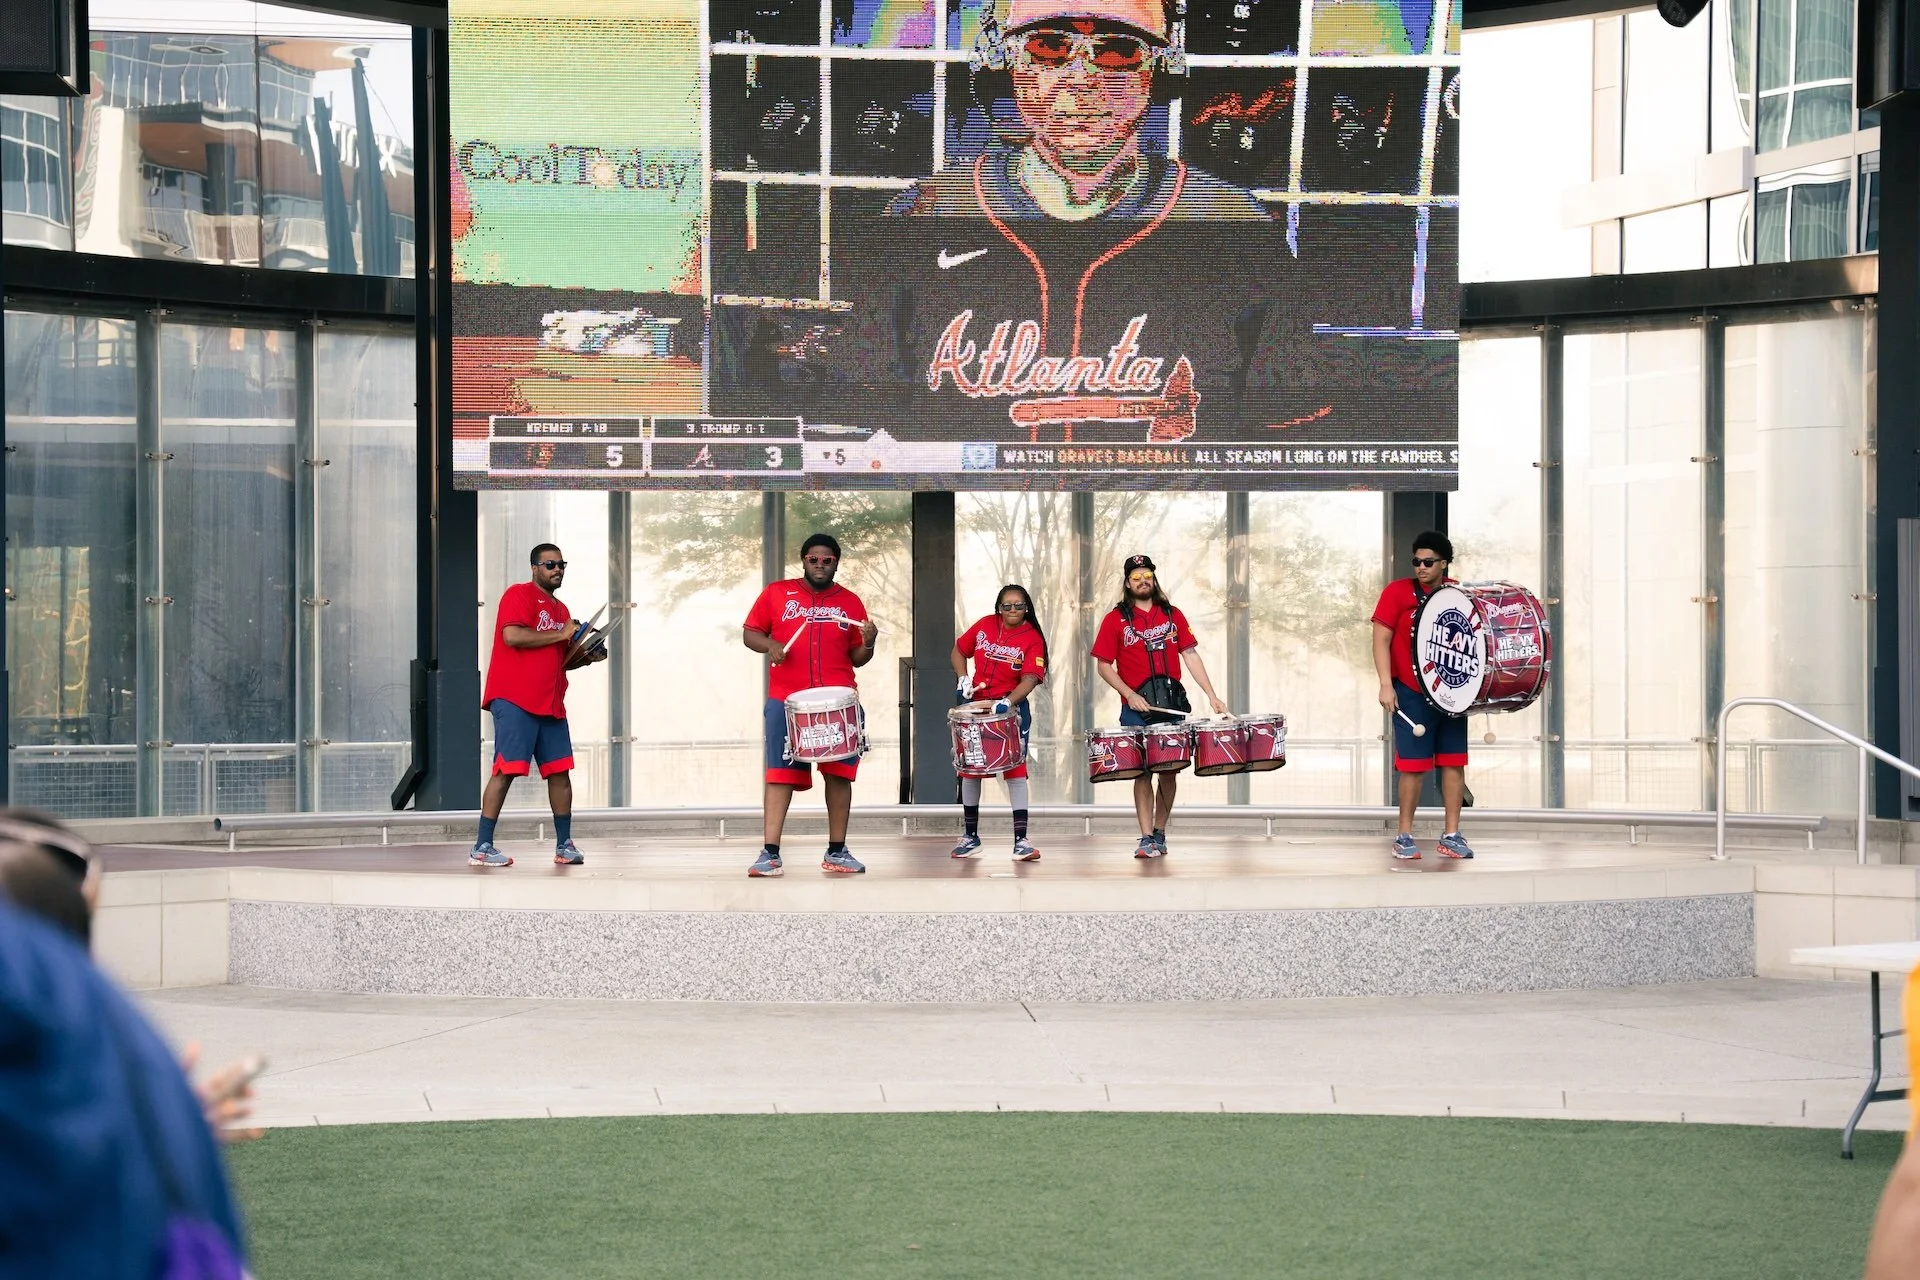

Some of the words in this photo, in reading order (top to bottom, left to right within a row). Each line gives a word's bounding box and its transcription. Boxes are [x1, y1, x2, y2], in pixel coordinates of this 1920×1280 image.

[927, 309, 1164, 397] Atlanta
[606, 445, 623, 467] 5
[765, 446, 783, 468] 3
[835, 448, 846, 466] 5
[1003, 449, 1054, 463] WATCH
[1116, 448, 1190, 464] BASEBALL
[1194, 450, 1221, 463] ALL
[1225, 450, 1282, 464] SEASON
[1285, 450, 1324, 463] LONG
[1327, 450, 1347, 463] ON
[1351, 450, 1377, 463] THE
[782, 599, 841, 621] Braves
[1442, 613, 1469, 632] ATLANTA
[975, 630, 1020, 657] Braves
[1431, 622, 1478, 656] HEAVY
[1426, 641, 1479, 677] HITTERS
[1496, 645, 1538, 660] HITTERS
[1437, 664, 1465, 685] BRAVES
[802, 733, 844, 748] HITTERS
